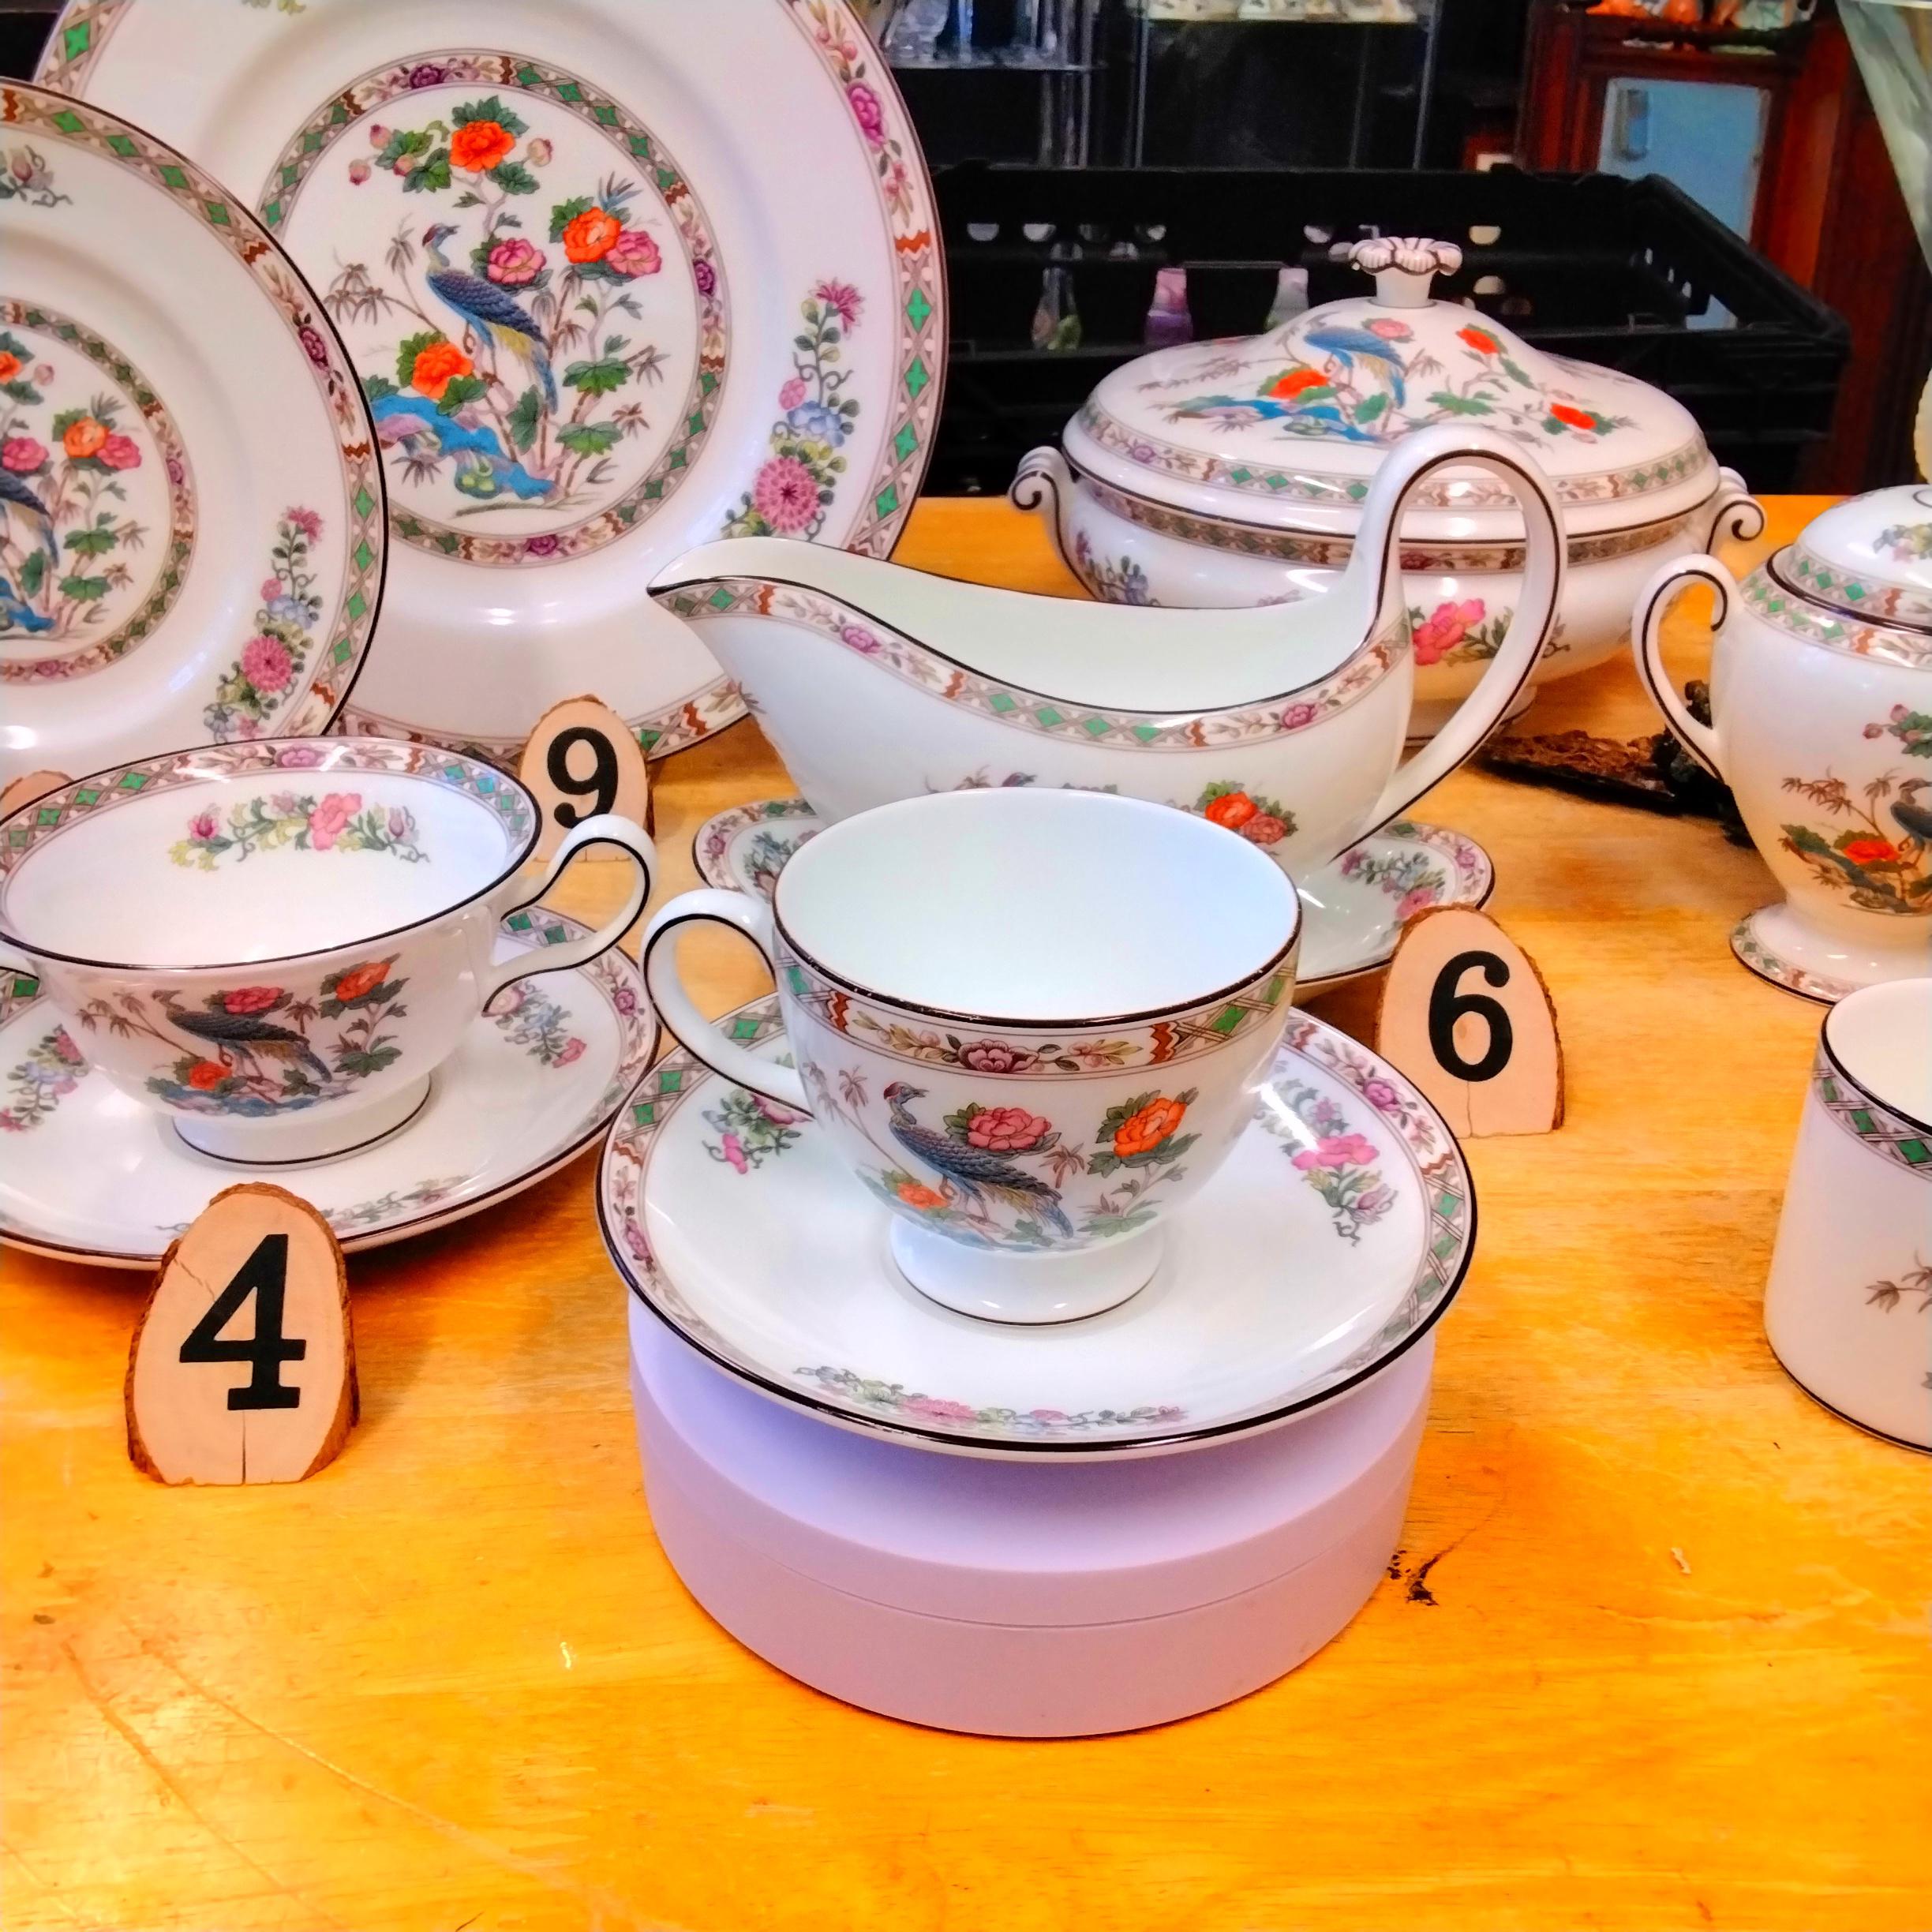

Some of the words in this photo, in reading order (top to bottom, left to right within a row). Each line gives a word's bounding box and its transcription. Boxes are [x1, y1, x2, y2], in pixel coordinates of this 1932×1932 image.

[547, 726, 618, 829] 9
[1428, 951, 1513, 1082] 6
[179, 1234, 306, 1411] 4
